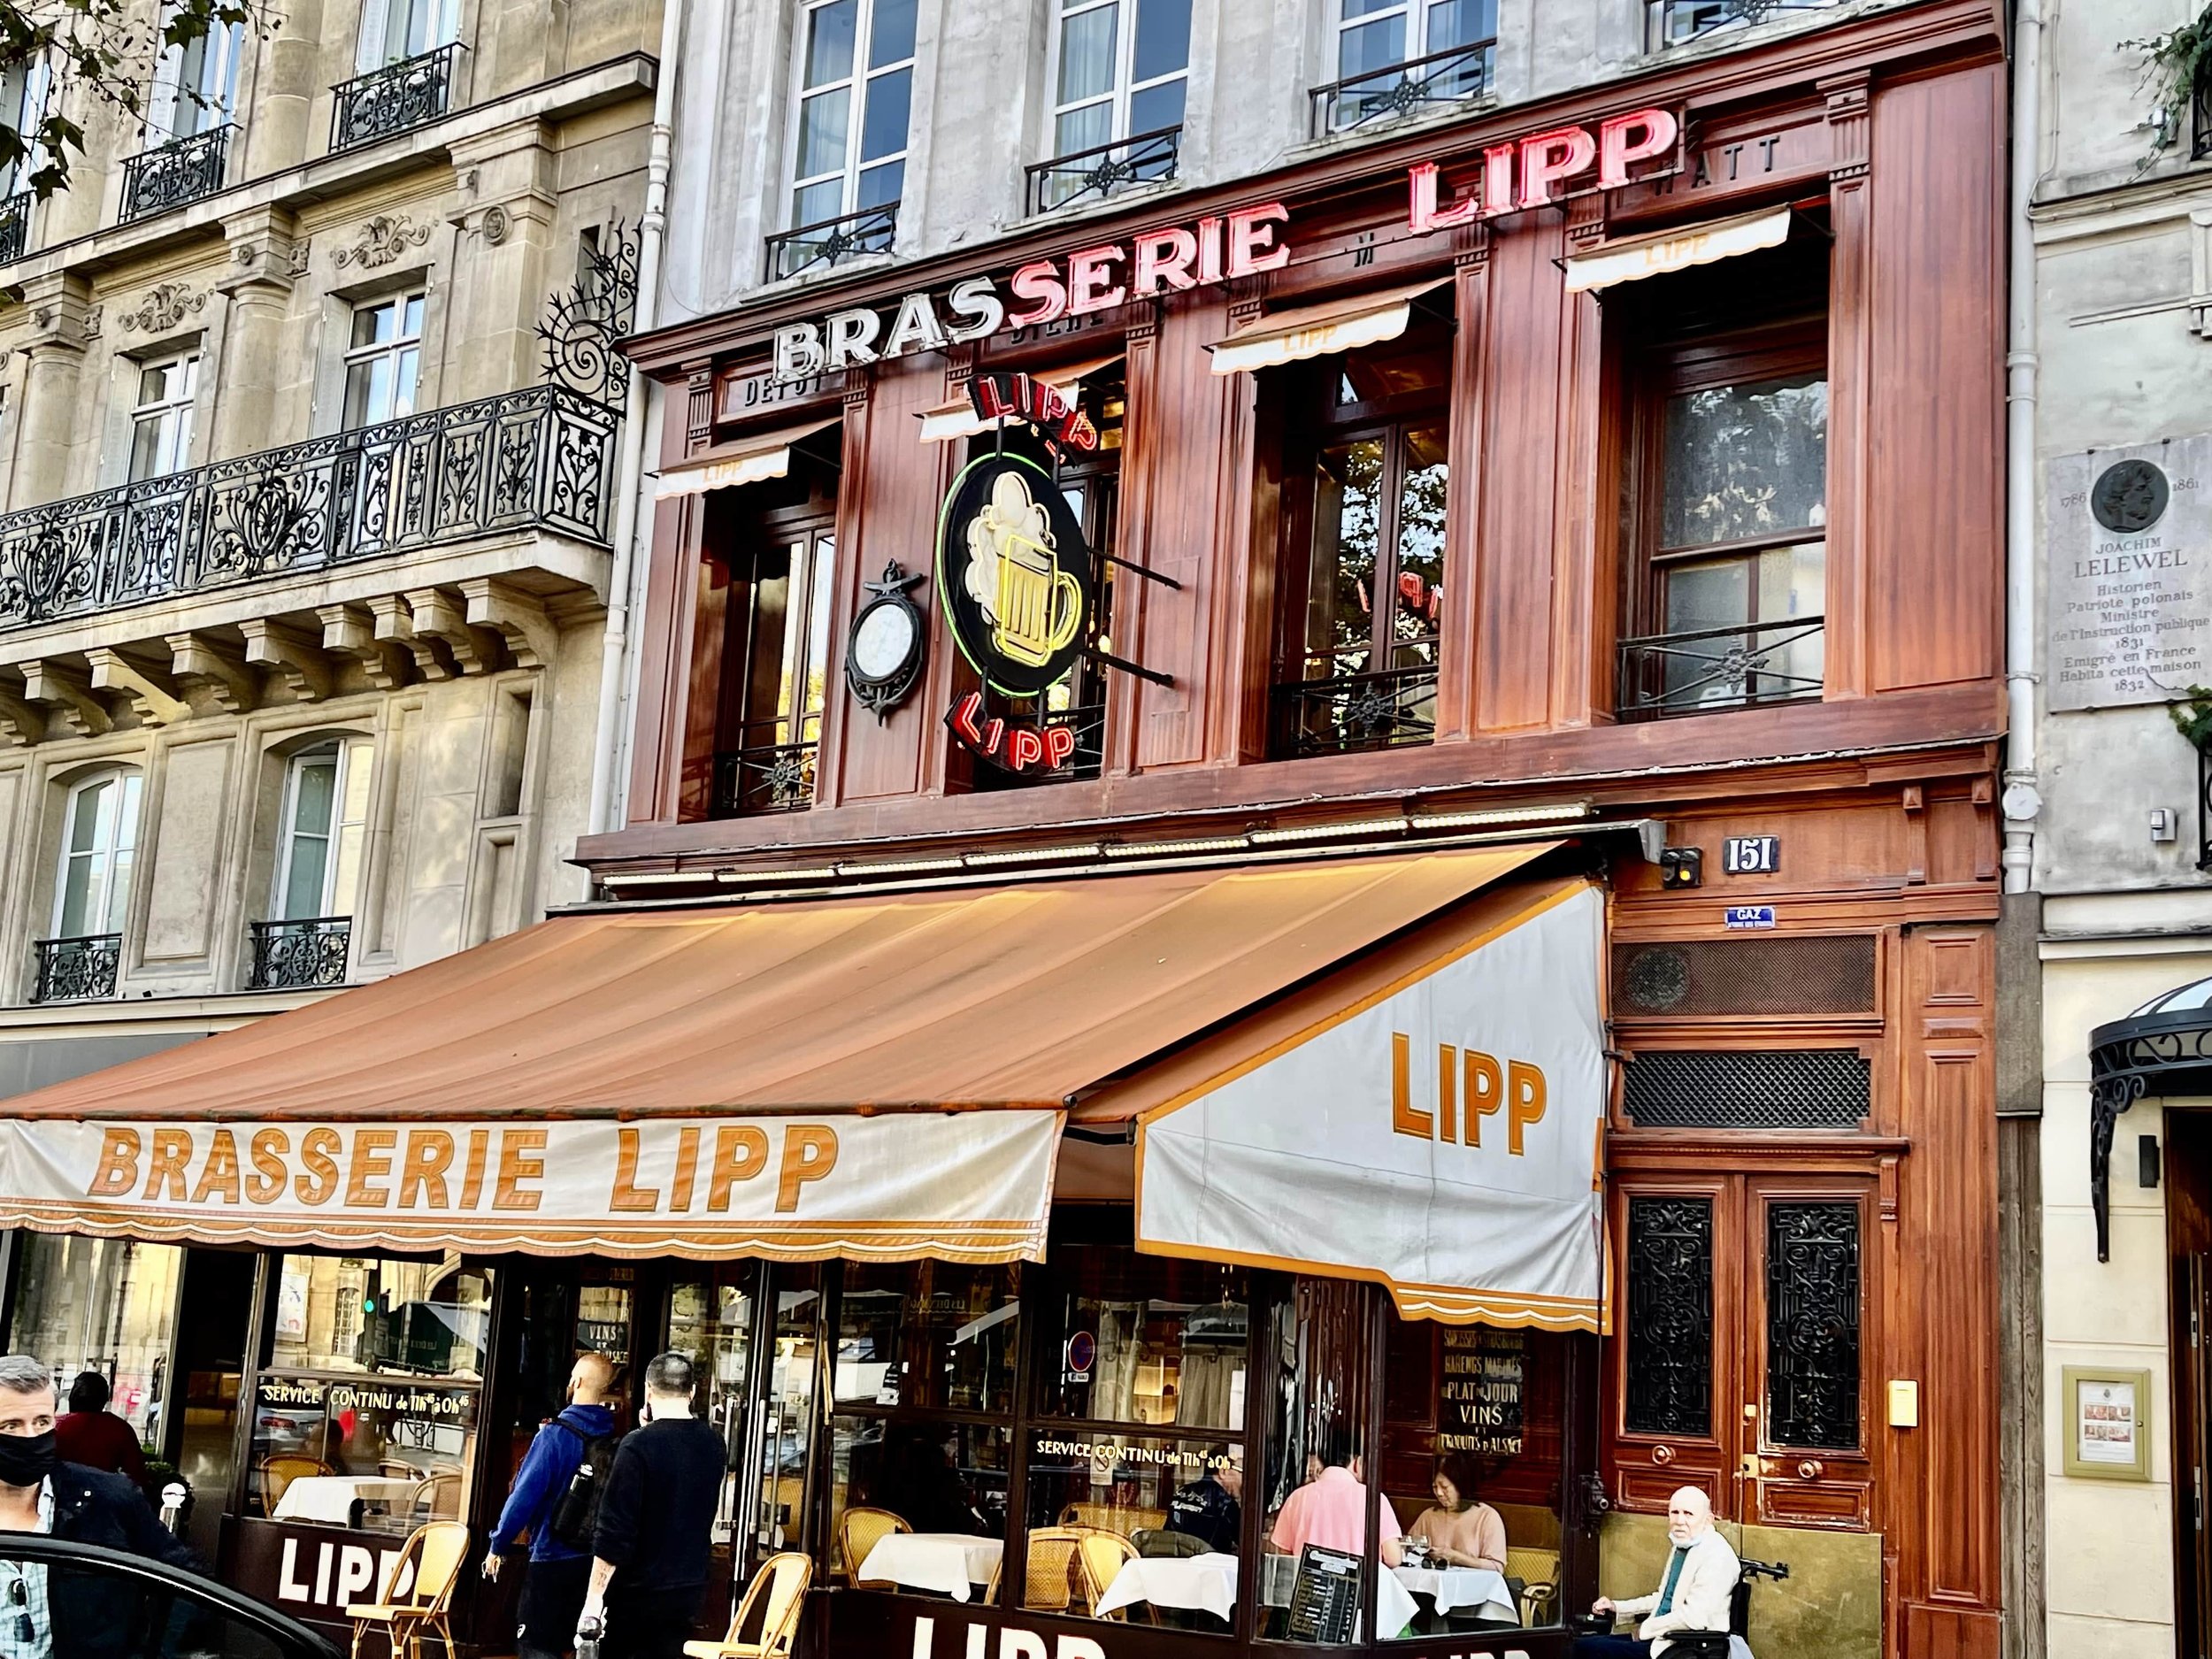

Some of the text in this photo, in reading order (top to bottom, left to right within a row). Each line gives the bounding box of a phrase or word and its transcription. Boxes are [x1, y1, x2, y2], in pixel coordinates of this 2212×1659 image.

[772, 109, 1678, 388] BRASSERIE LIPP
[1645, 232, 1709, 265] LIPP
[1284, 324, 1338, 352] LIPP
[979, 372, 1097, 450] LIPP
[703, 459, 743, 482] LIPP
[2172, 478, 2200, 492] 1861
[2060, 493, 2087, 508] 1786
[2095, 536, 2162, 555] JOACHIM
[2074, 549, 2188, 579] LELEWEL
[2097, 580, 2162, 596] Historien
[2067, 590, 2193, 613] Patriote polonais
[2101, 608, 2160, 624] Ministre
[2052, 630, 2068, 643] de
[2155, 617, 2210, 634] publique
[2116, 636, 2144, 649] 1831
[2124, 651, 2139, 663] en
[2146, 646, 2197, 661] France
[2060, 660, 2202, 683] Habita cette maison
[2115, 680, 2145, 693] 1832
[961, 691, 1075, 771] LIPP
[1728, 837, 1772, 872] 151
[1737, 908, 1762, 920] GAZ
[1392, 1031, 1548, 1157] LIPP
[88, 1123, 840, 1213] BRASSERIE LIPP
[589, 1325, 617, 1341] VINS
[265, 1385, 320, 1404] SERVICE
[330, 1389, 392, 1409] CONTINU
[396, 1394, 408, 1410] de
[1448, 1381, 1476, 1401] PLAT
[1484, 1382, 1517, 1403] JOUR
[1460, 1404, 1503, 1425] VINS
[1036, 1440, 1092, 1458] SERVICE
[1095, 1444, 1165, 1464] CONTINU
[1166, 1451, 1181, 1465] de
[279, 1538, 415, 1608] LIPP
